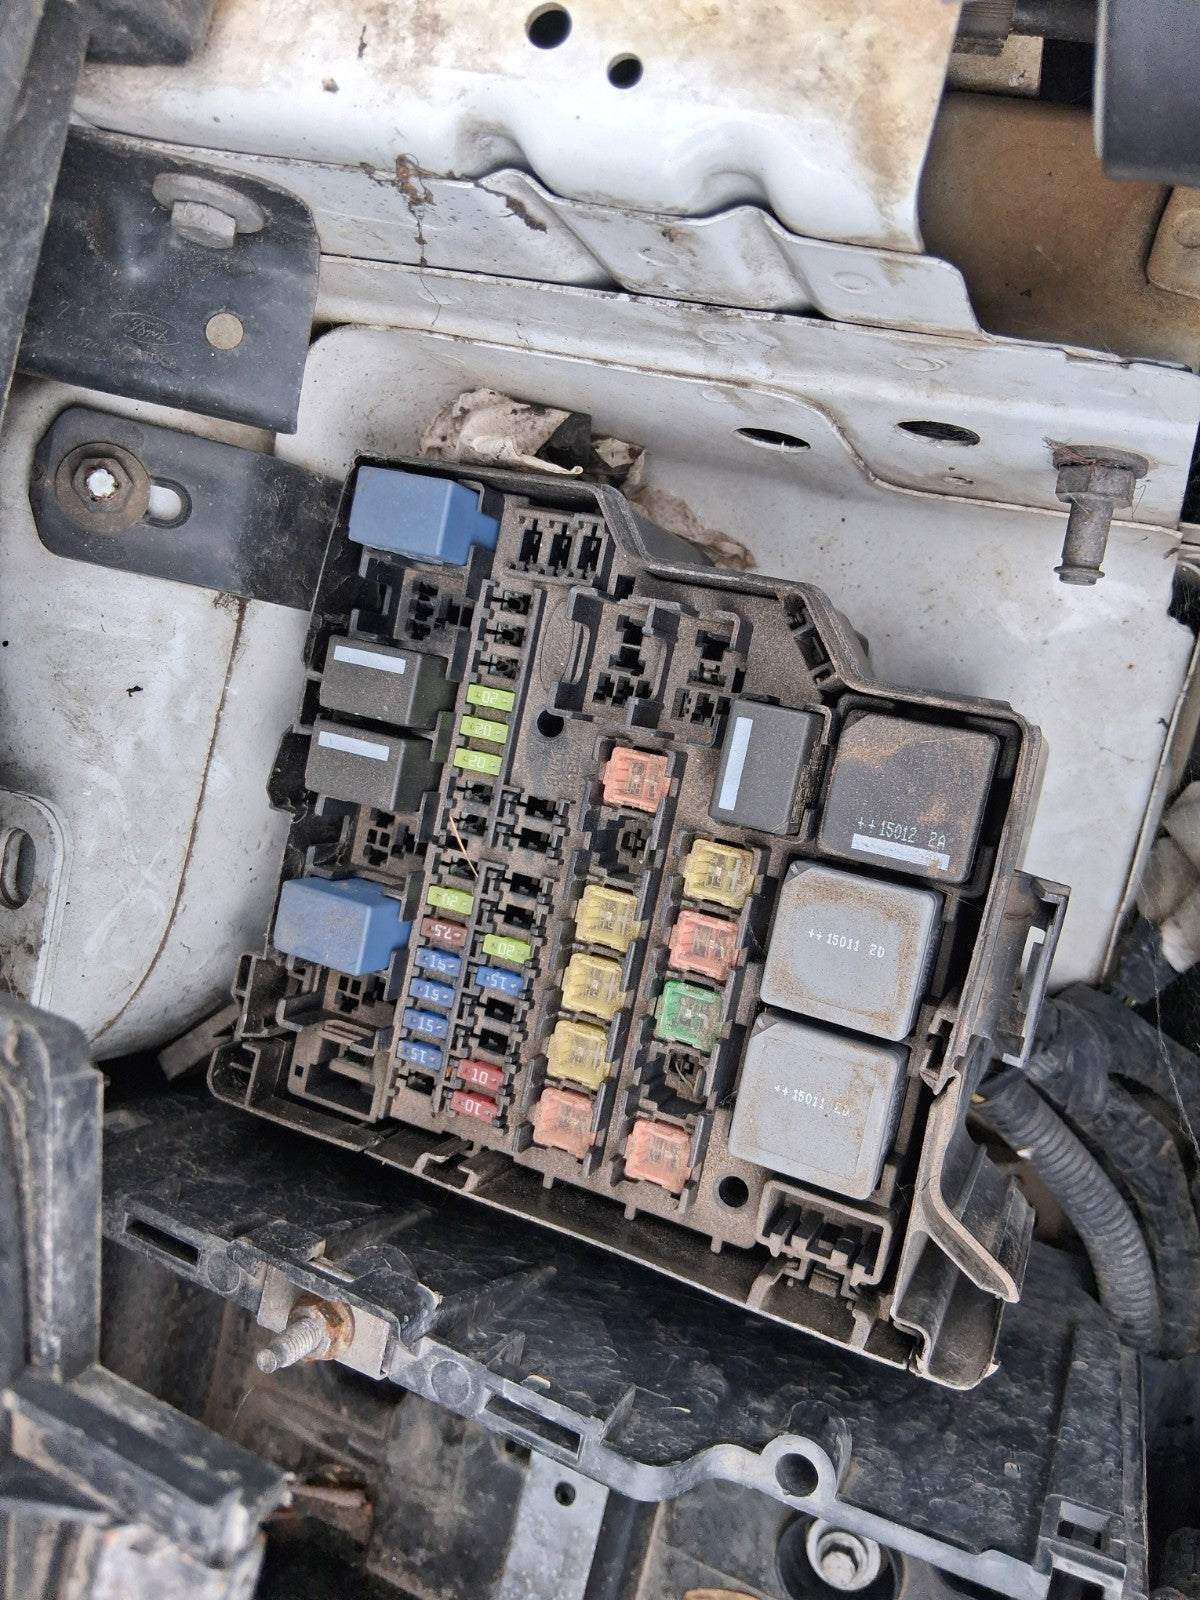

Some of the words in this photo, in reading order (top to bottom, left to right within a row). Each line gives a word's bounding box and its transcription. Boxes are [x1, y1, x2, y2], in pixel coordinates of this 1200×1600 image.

[481, 690, 499, 703] 20
[475, 723, 492, 737] 20
[469, 755, 486, 769] 20
[927, 831, 946, 851] 2A
[441, 893, 459, 907] 20
[434, 924, 452, 940] 7.5
[497, 942, 515, 957] 20
[869, 943, 886, 958] 2D
[430, 954, 446, 971] 15
[490, 973, 507, 990] 15
[423, 985, 439, 1001] 15
[418, 1017, 434, 1032] 15
[411, 1047, 427, 1063] 15
[471, 1068, 489, 1085] 10
[465, 1099, 482, 1116] 10
